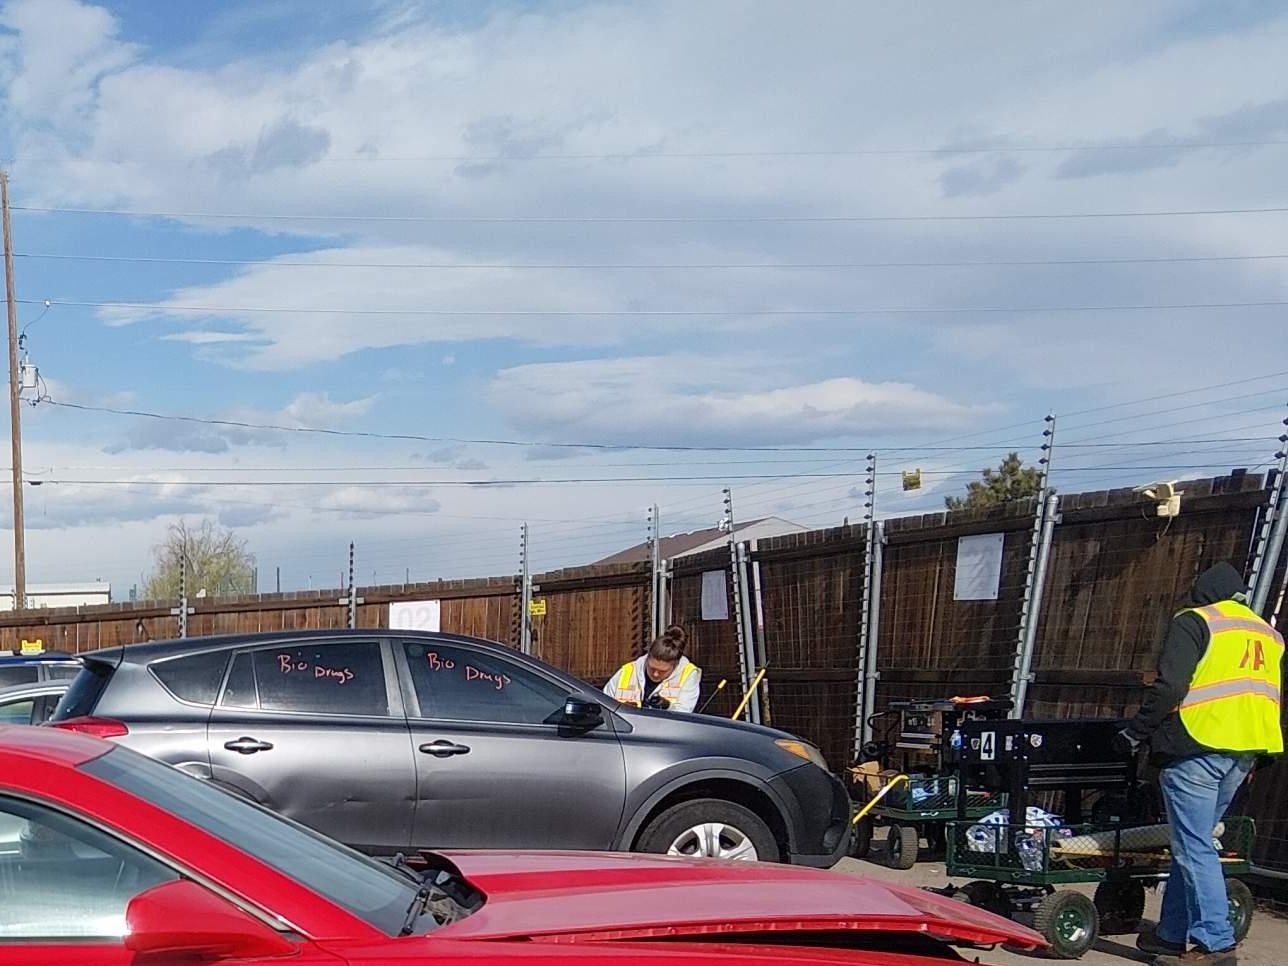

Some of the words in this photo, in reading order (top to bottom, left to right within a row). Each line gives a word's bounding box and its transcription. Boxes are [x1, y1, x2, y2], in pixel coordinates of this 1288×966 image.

[278, 654, 307, 673] Bio
[314, 666, 354, 684] Drugs
[427, 652, 455, 671] Bio
[465, 666, 512, 690] Drugs
[982, 733, 993, 759] 4
